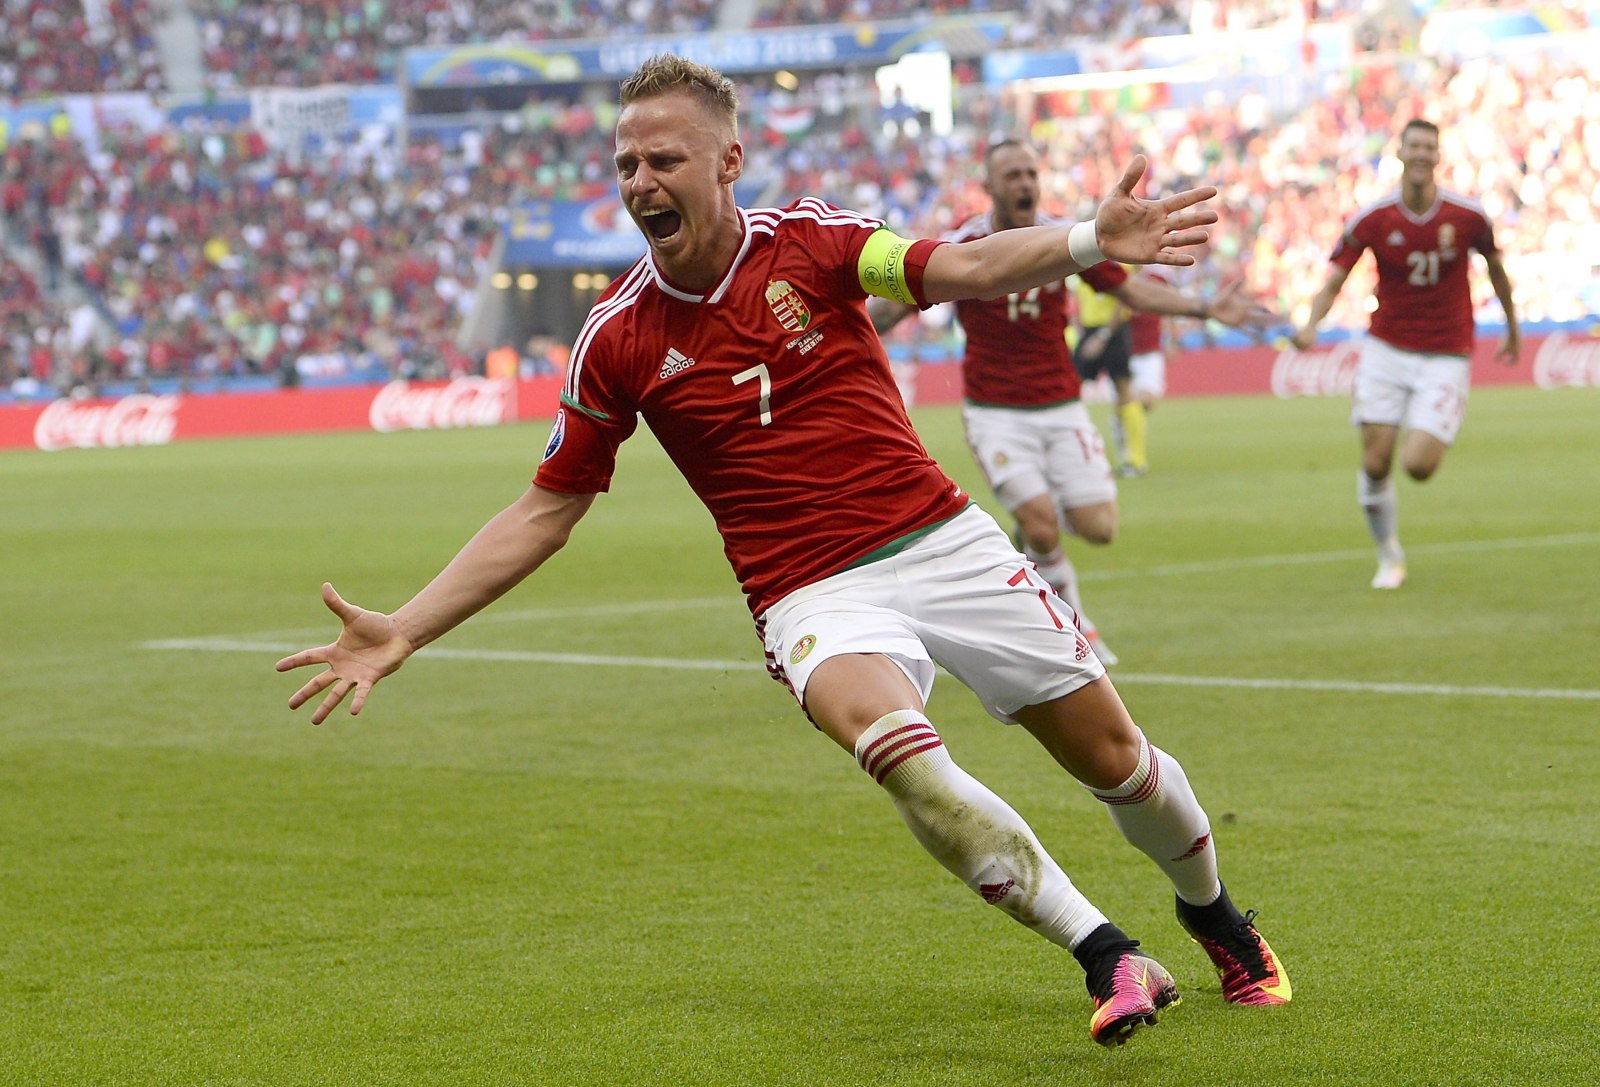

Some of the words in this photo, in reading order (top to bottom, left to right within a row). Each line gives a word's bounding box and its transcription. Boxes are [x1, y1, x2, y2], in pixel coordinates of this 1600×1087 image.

[886, 243, 905, 282] RACISM
[1406, 250, 1439, 286] 21
[660, 357, 696, 380] adidas
[731, 363, 773, 427] 7
[33, 393, 182, 452] Coca-Cola
[1006, 567, 1064, 631] 7
